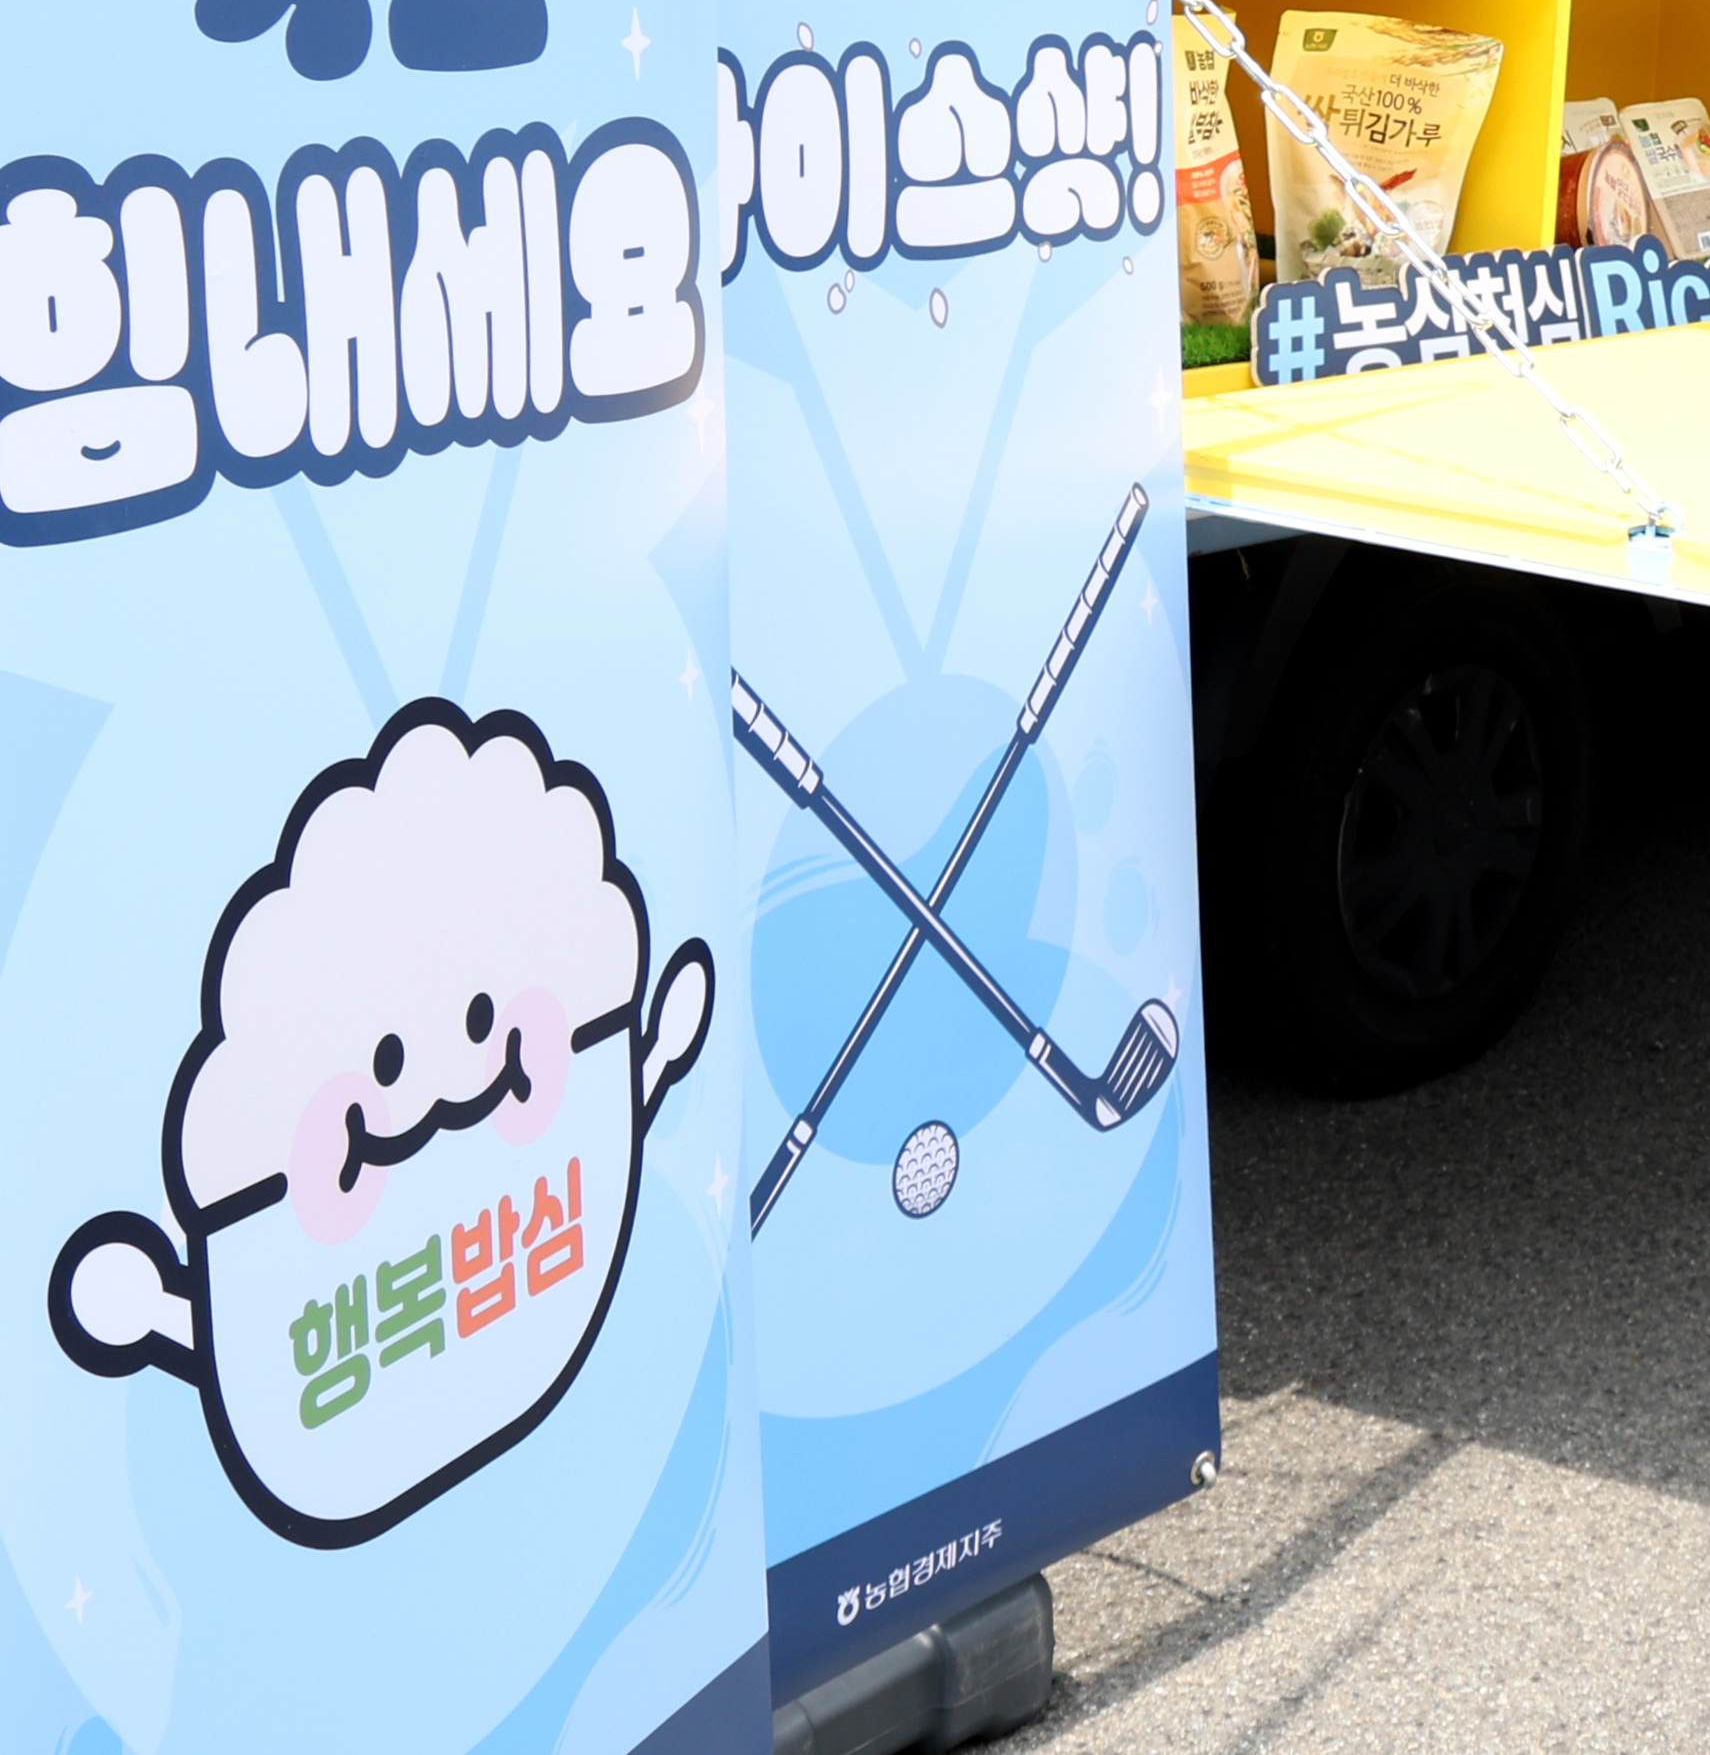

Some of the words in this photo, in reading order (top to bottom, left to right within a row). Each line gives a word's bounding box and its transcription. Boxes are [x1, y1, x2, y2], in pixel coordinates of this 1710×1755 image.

[719, 30, 1165, 284] 이스샷!
[0, 117, 706, 548] 힘내세요
[863, 1518, 1005, 1612] 농협경제지주
